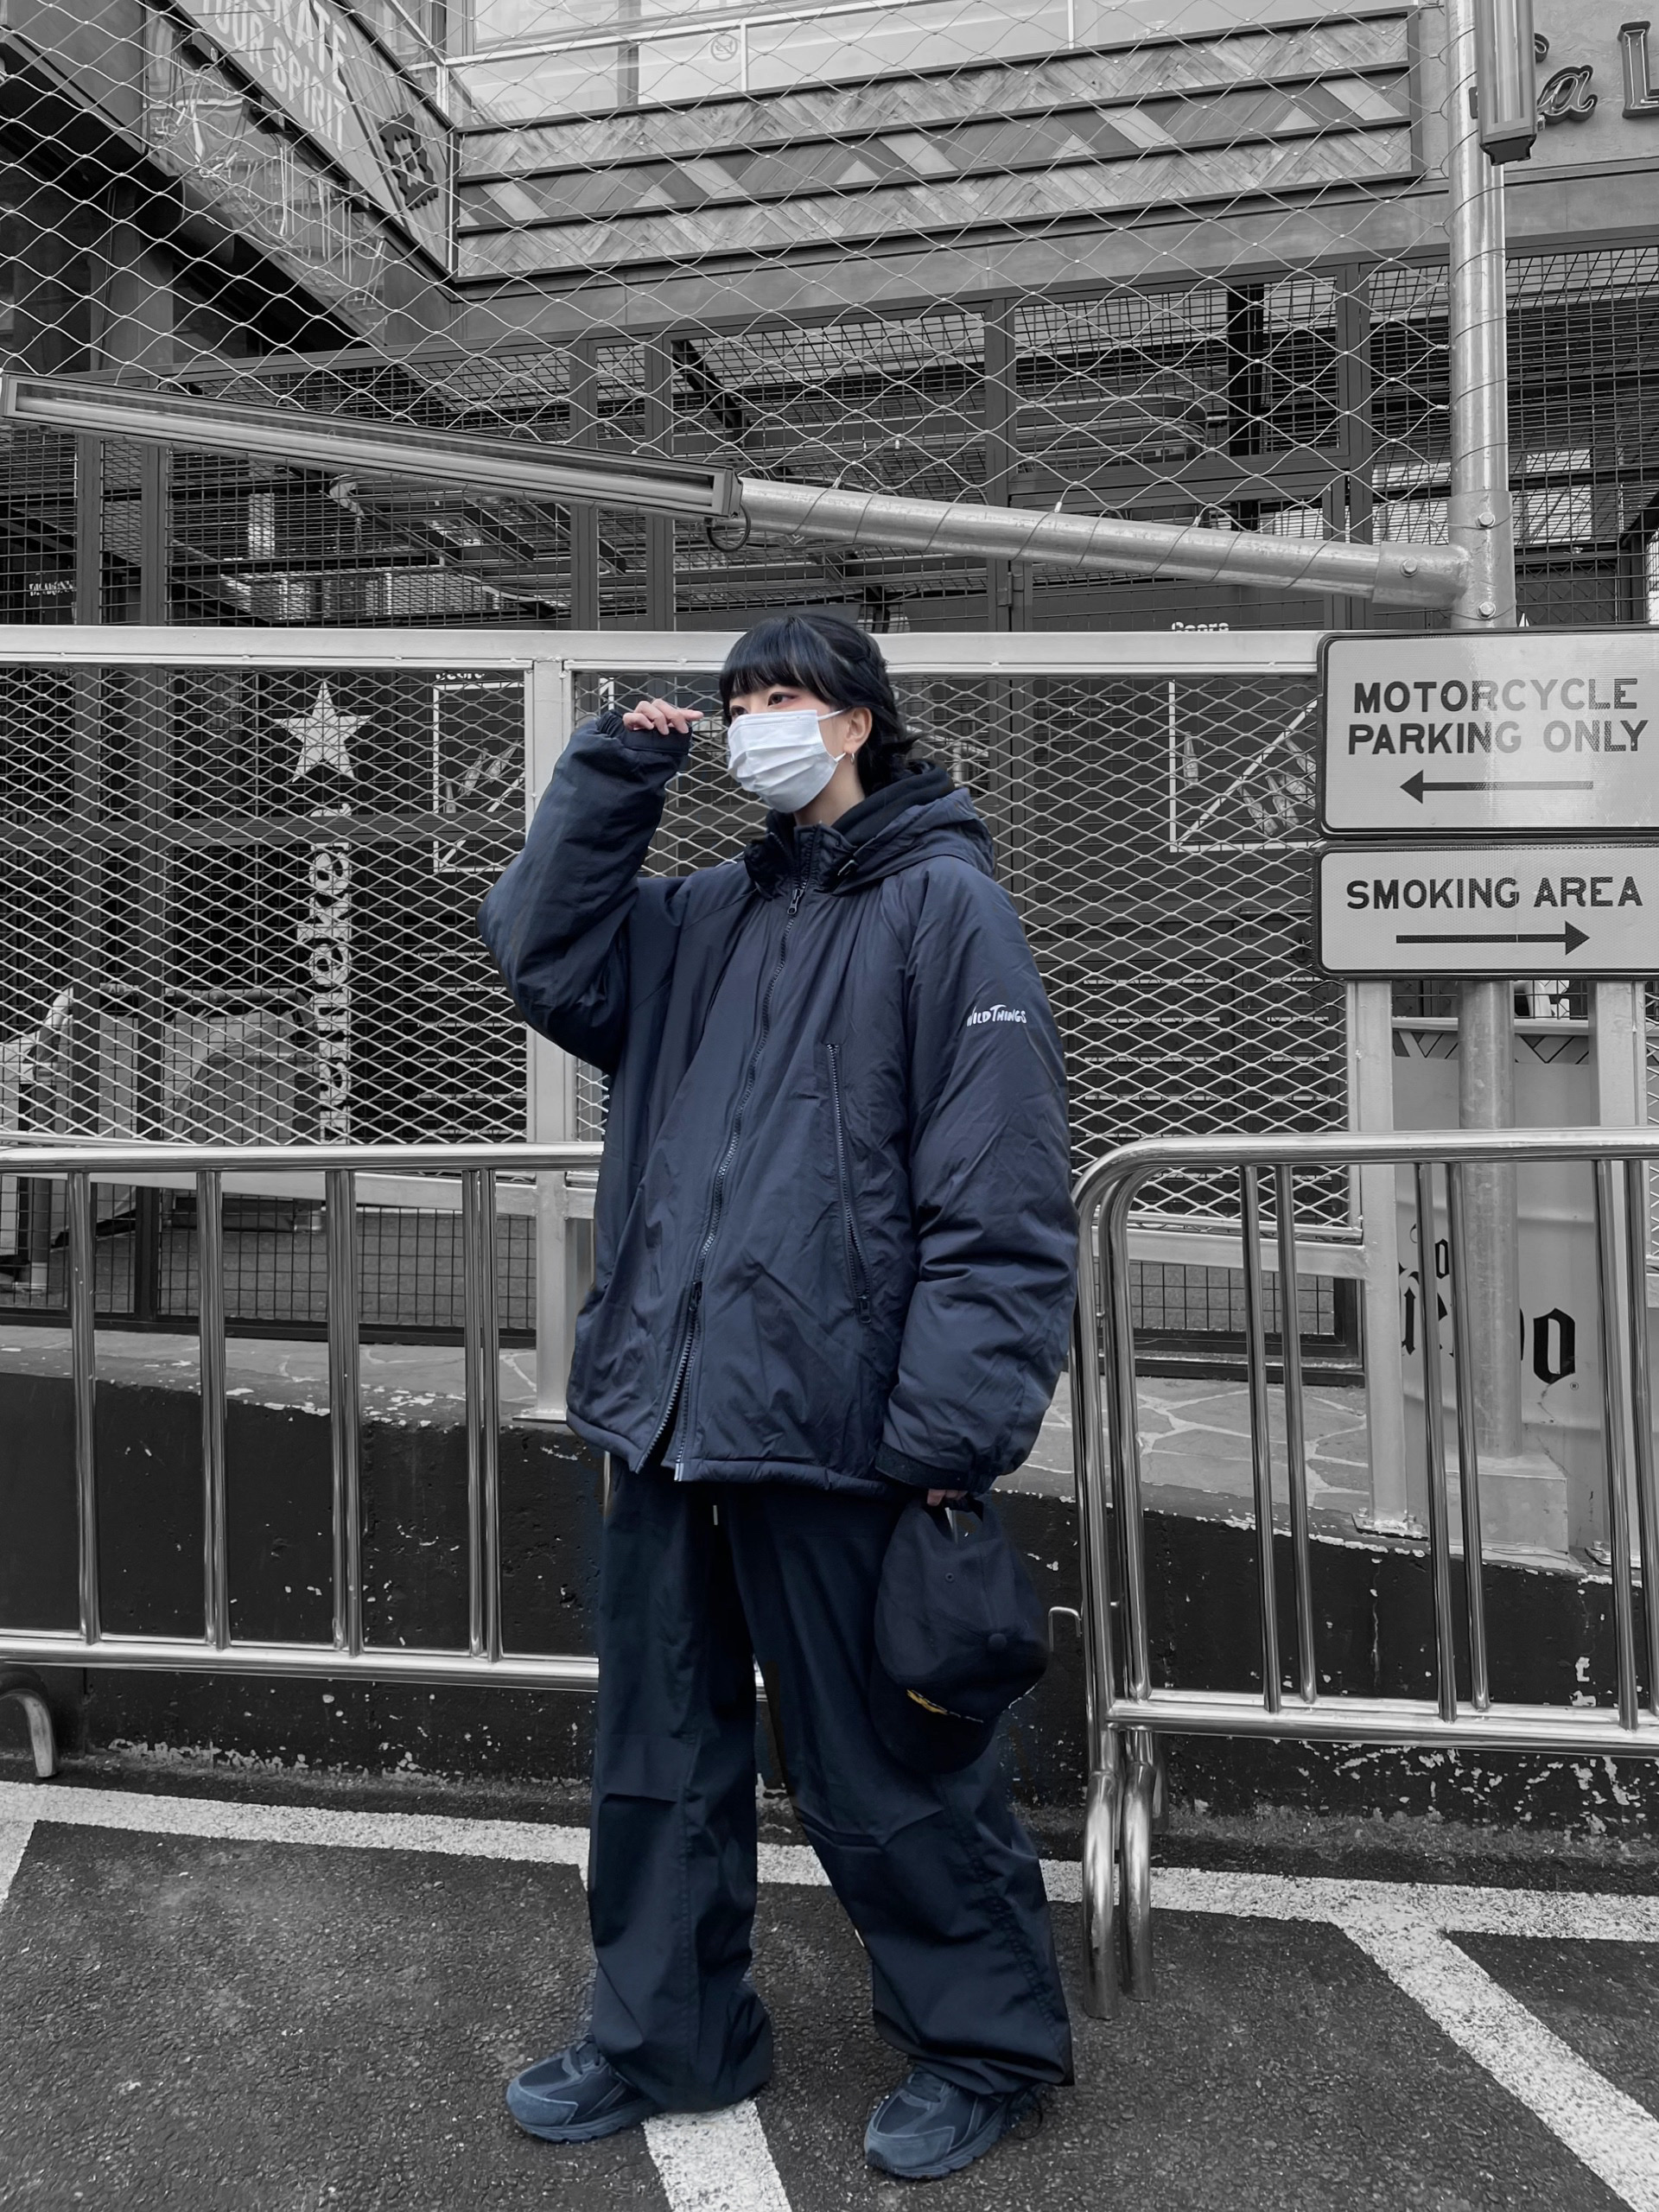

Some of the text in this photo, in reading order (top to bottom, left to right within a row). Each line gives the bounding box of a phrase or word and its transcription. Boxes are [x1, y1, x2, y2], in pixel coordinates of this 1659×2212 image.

[272, 36, 346, 151] SPIRIT
[1354, 678, 1638, 714] MOTORCYCLE
[1348, 719, 1649, 755] PARKING ONLY
[1345, 875, 1643, 910] SMOKING AREA
[989, 1004, 1027, 1024] THINGS
